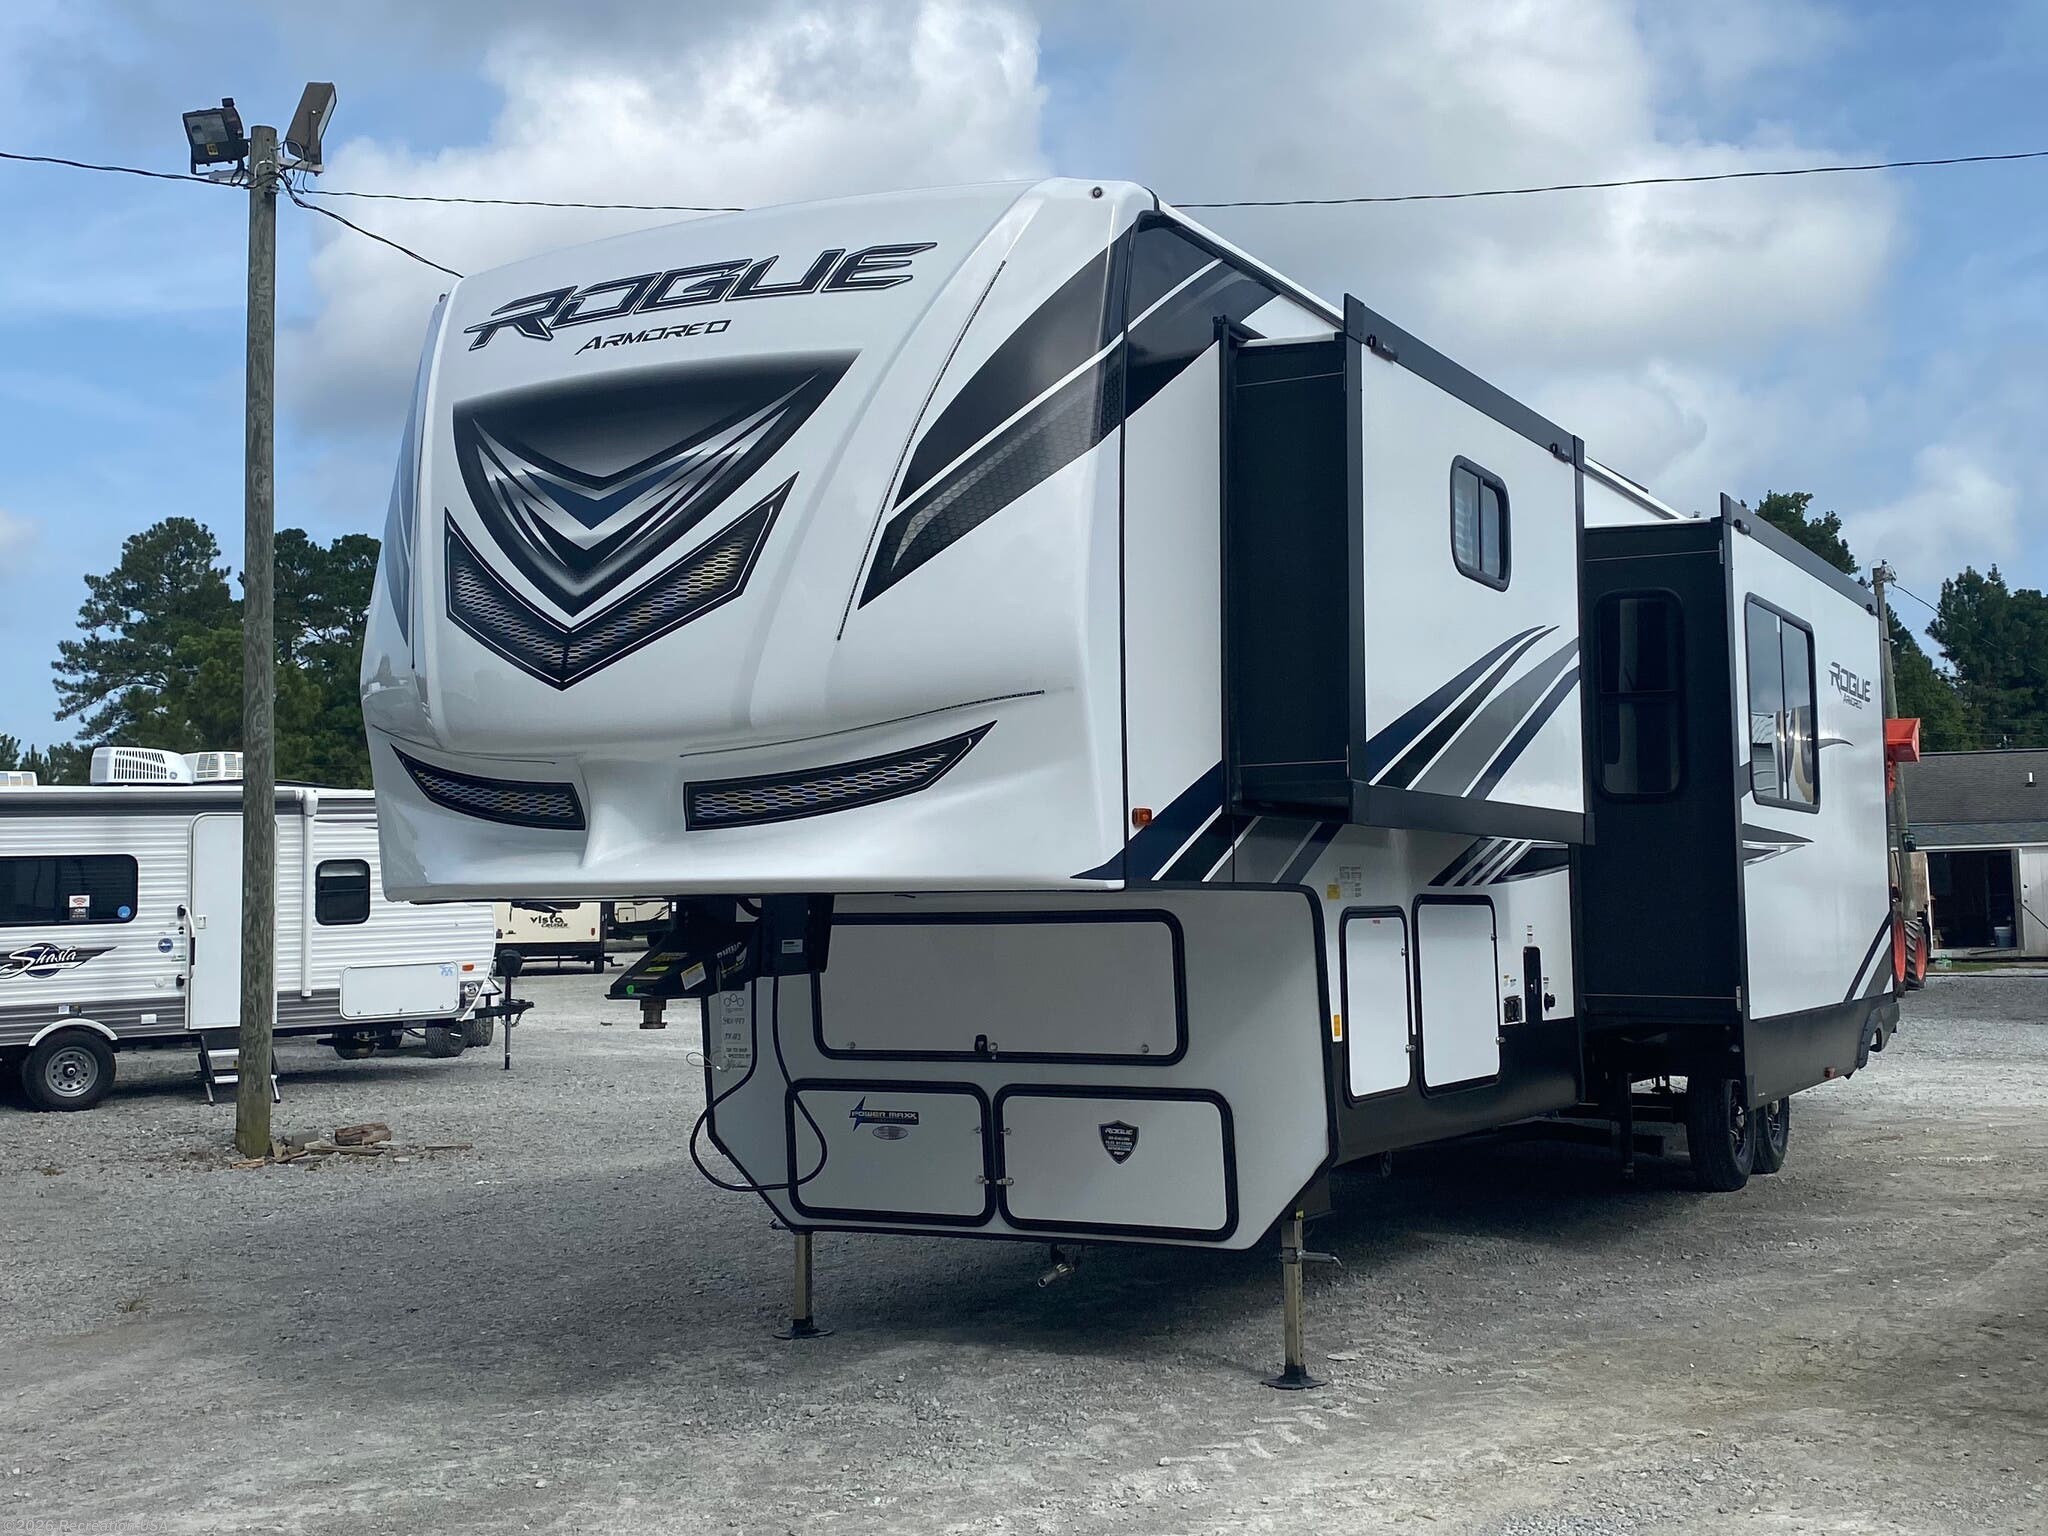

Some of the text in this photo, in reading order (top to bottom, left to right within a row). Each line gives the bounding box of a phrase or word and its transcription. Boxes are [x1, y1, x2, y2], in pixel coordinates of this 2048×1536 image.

[463, 242, 938, 352] ROGUE
[574, 319, 732, 356] ARMORED
[1828, 661, 1871, 703] ROGUE
[0, 945, 77, 979] Shasta
[1104, 1127, 1134, 1136] ROGUE
